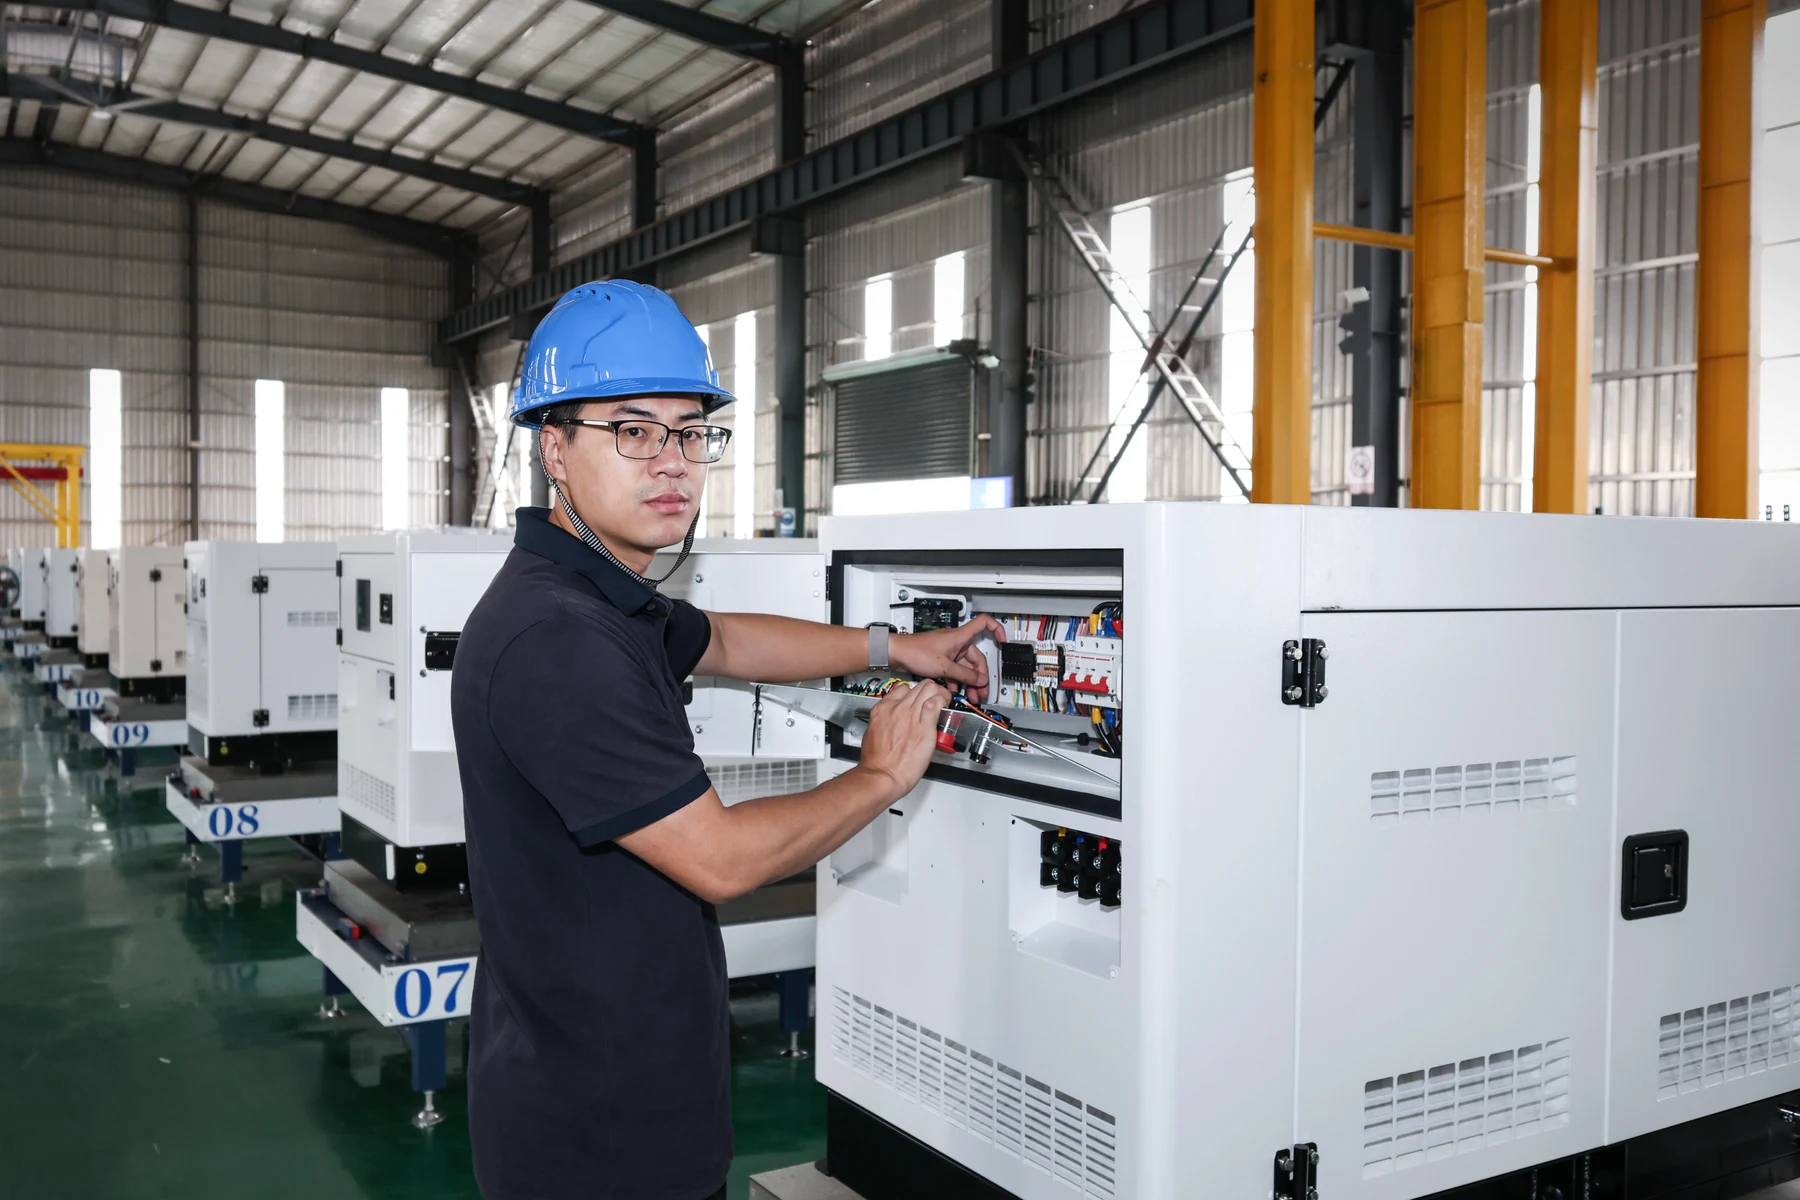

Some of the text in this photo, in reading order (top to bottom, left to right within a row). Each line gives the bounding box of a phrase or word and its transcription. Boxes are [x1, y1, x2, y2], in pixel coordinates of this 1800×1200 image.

[48, 665, 63, 680] 11
[76, 690, 100, 708] 10
[113, 724, 149, 745] 09
[209, 804, 259, 837] 08
[394, 962, 470, 1019] 07
